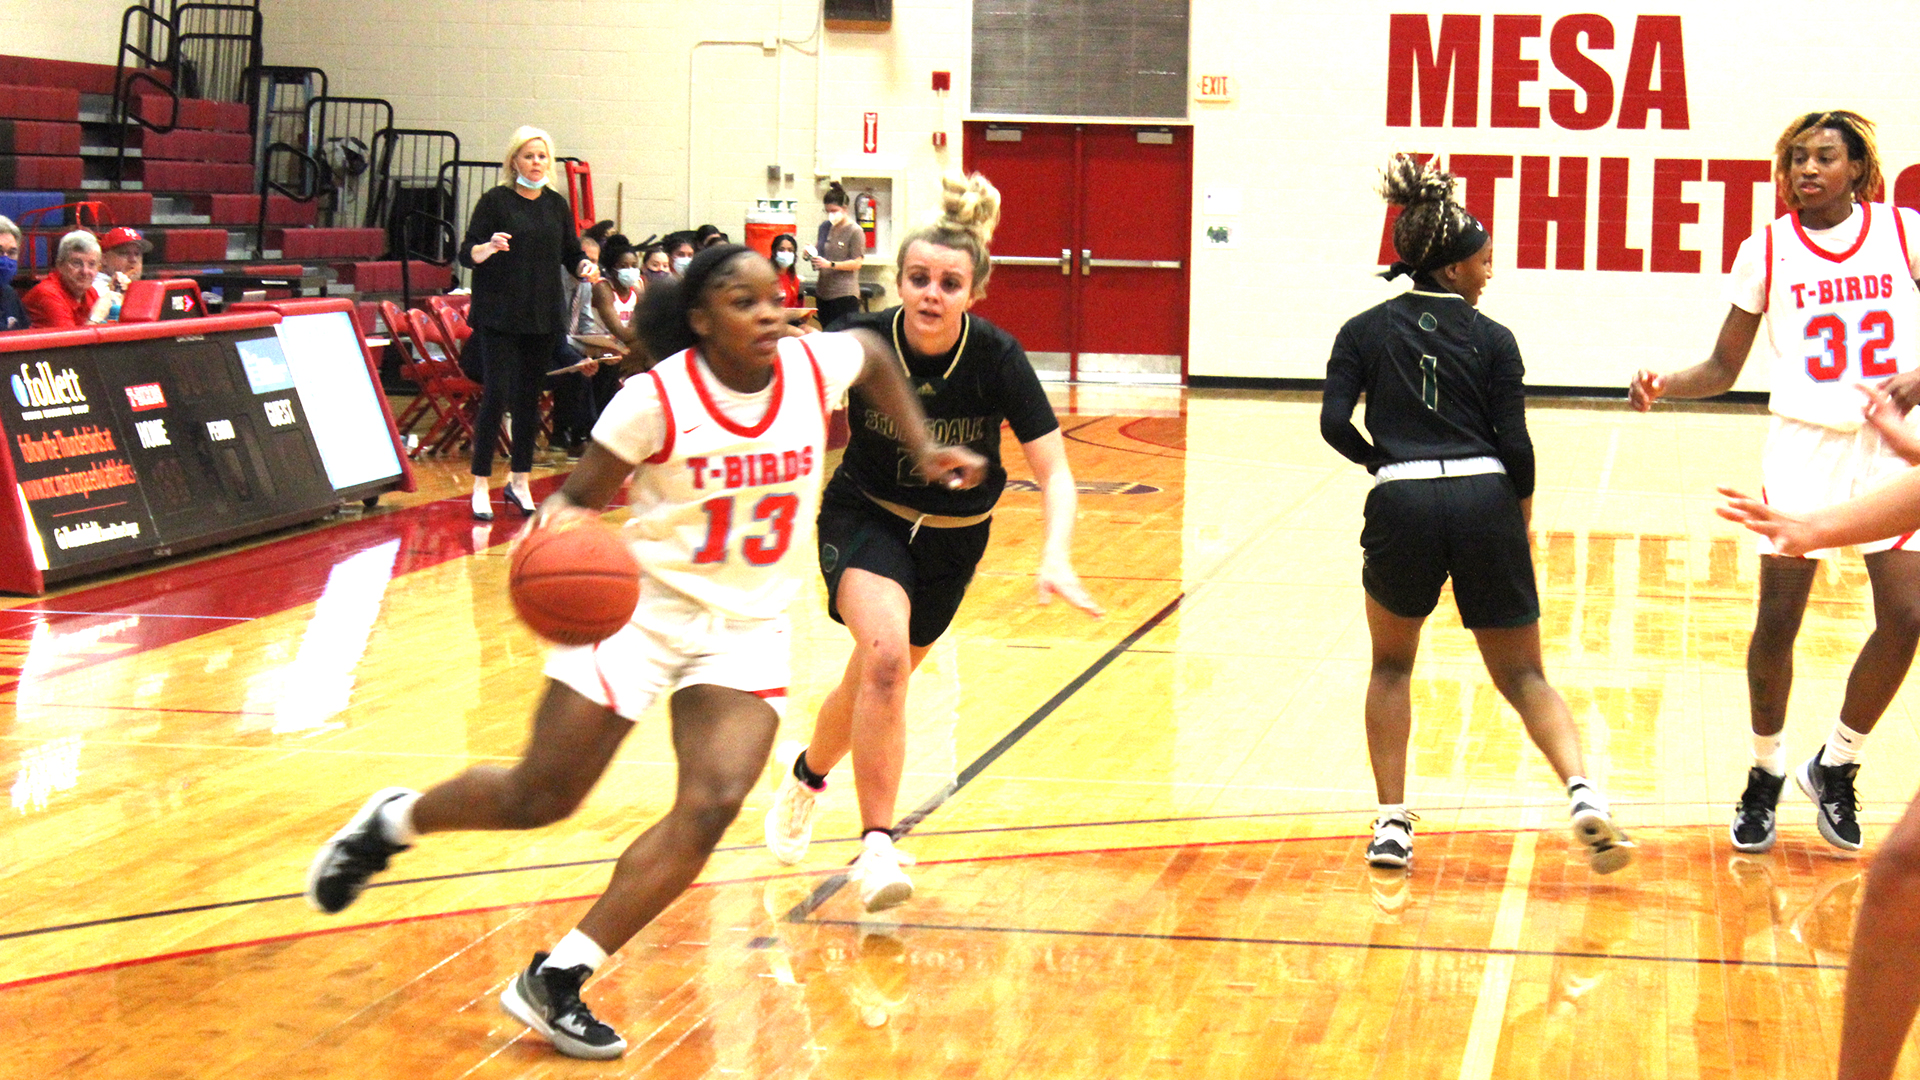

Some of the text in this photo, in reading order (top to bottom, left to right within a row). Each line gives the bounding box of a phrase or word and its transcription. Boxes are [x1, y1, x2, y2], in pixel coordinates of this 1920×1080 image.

[1202, 75, 1228, 96] EXIT
[1386, 13, 1690, 131] MESA
[1791, 273, 1893, 309] T-BIRDS
[1803, 309, 1899, 383] 32
[20, 360, 87, 407] follett
[1420, 354, 1439, 412] 1
[134, 418, 171, 449] HOME
[263, 399, 296, 427] GUEST
[686, 445, 814, 489] T-BIRDS
[691, 492, 800, 567] 13
